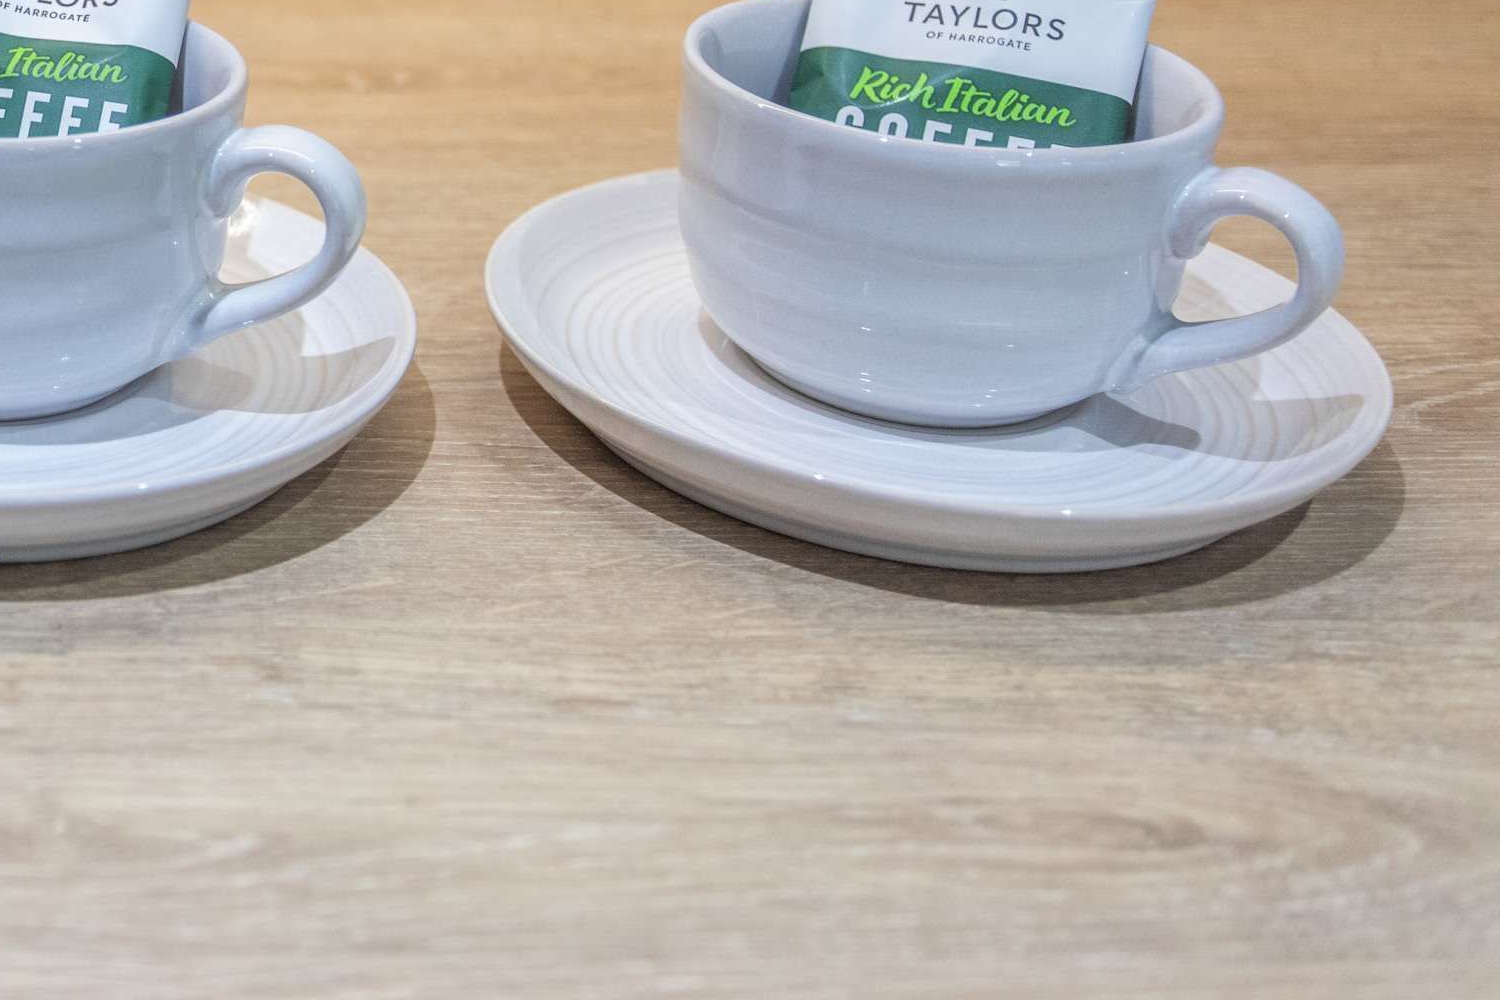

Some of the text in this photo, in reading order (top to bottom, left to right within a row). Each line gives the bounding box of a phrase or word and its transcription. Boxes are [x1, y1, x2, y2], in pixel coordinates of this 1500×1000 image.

[14, 4, 91, 23] HARROGATE
[904, 1, 1066, 41] TAYLORS
[926, 30, 1032, 52] OF HARROGATE
[0, 46, 128, 84] Italian
[849, 66, 936, 110] Rich
[936, 77, 1077, 127] Italian
